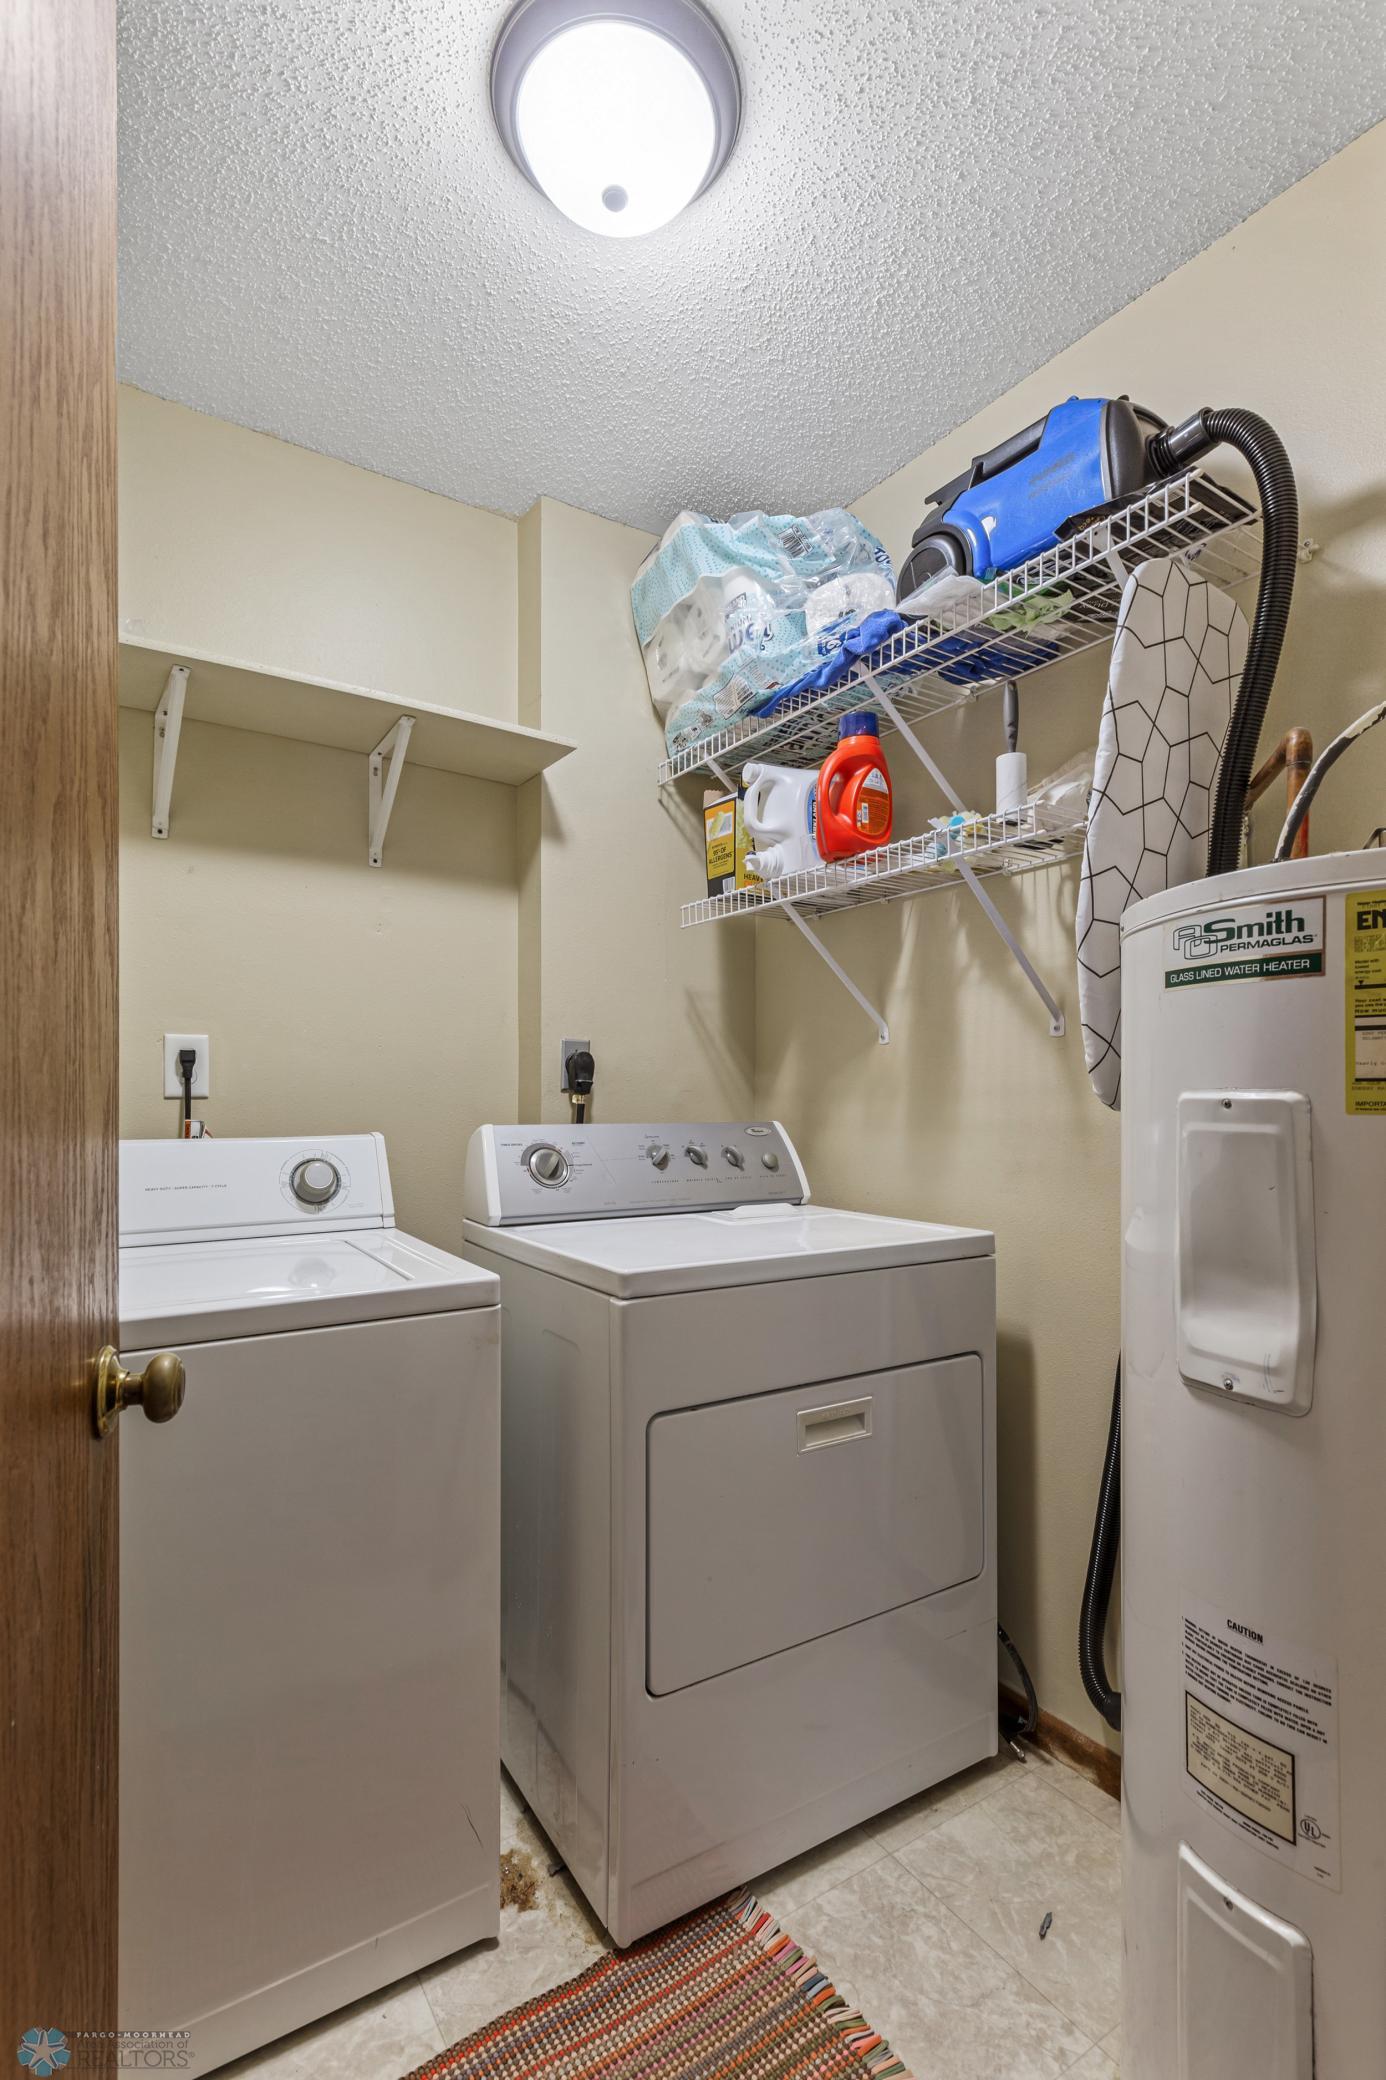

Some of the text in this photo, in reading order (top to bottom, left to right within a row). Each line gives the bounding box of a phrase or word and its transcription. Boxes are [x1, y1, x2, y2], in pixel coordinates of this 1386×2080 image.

[1203, 909, 1305, 944] Smith
[1220, 934, 1314, 953] PERMAGLAS
[1170, 959, 1310, 983] GLASS LINED WATER HEATER
[1226, 1619, 1264, 1644] CAUTION
